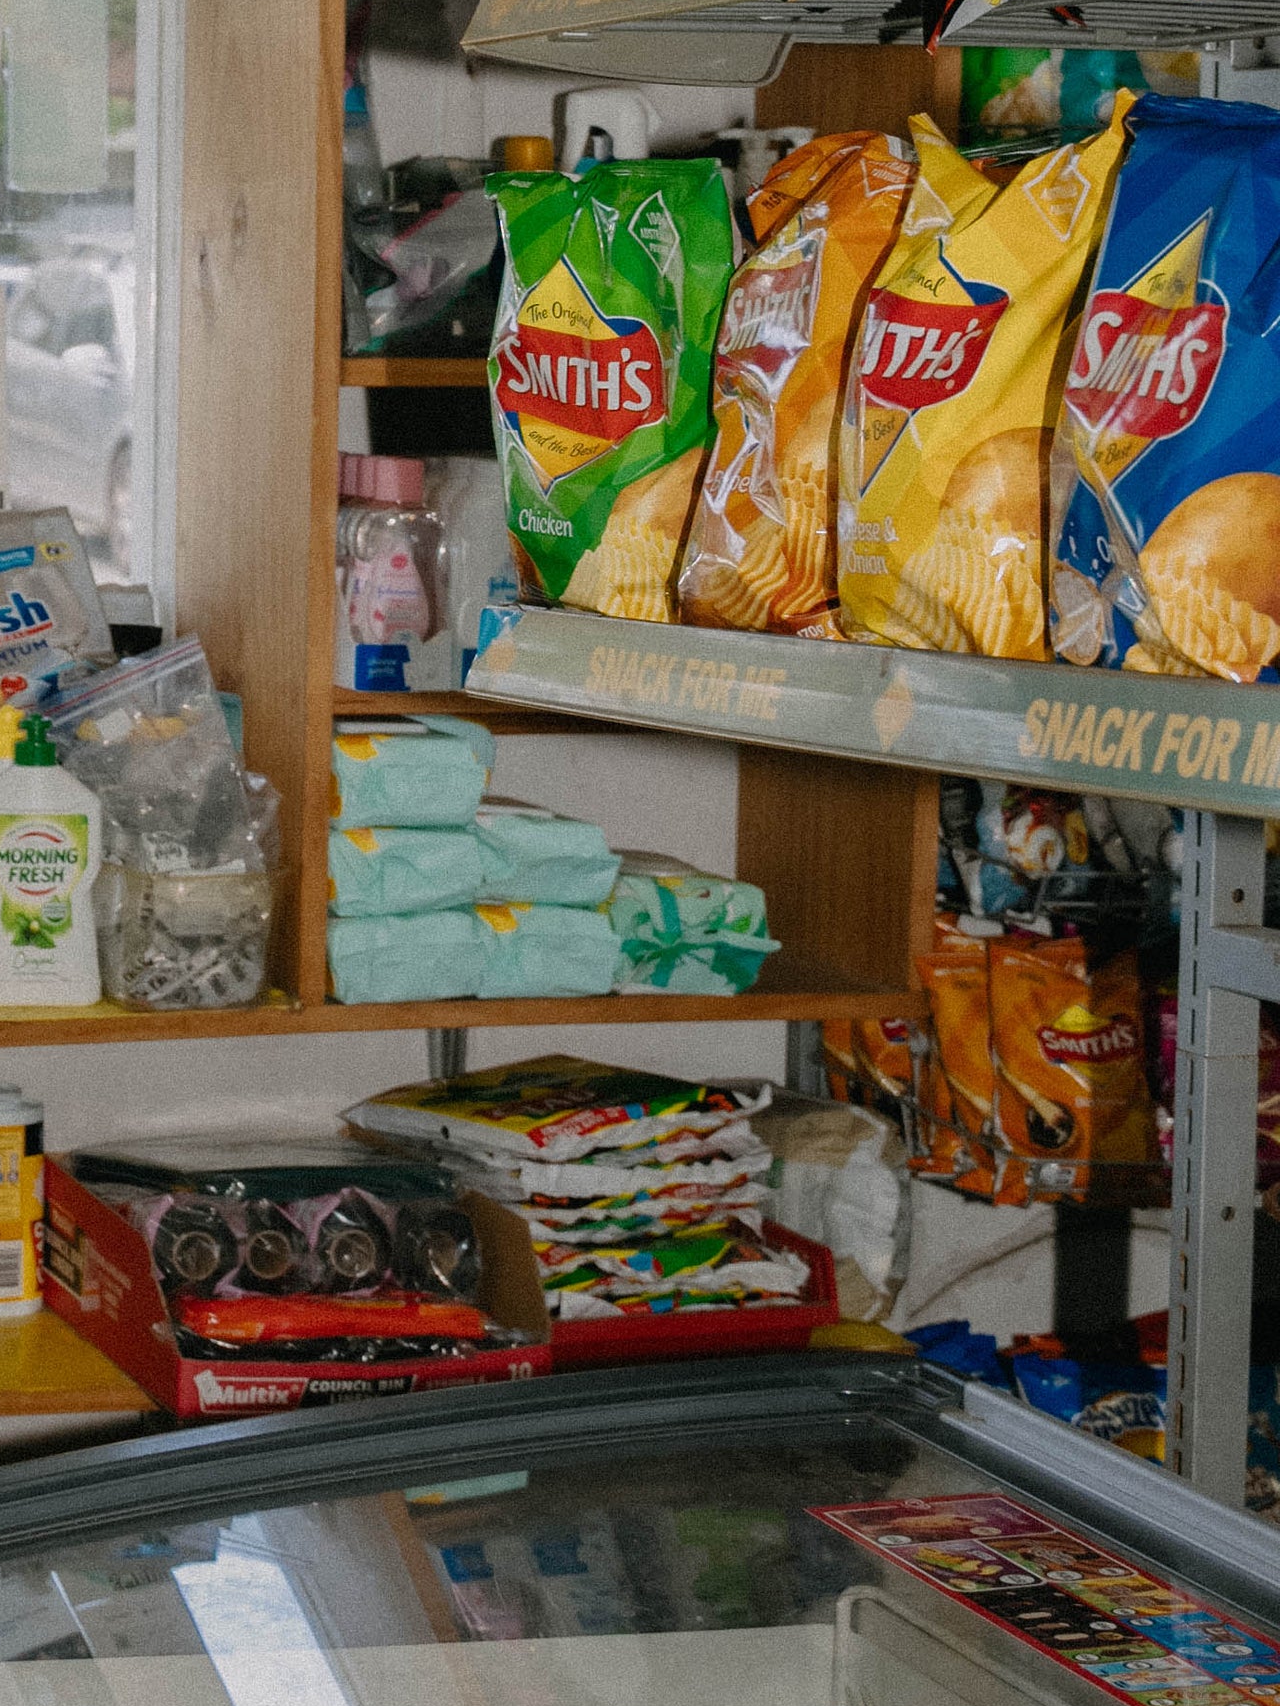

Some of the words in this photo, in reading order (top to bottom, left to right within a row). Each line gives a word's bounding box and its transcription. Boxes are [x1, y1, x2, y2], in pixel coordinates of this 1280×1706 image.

[526, 299, 550, 323] The
[551, 301, 594, 334] Original
[1068, 310, 1208, 404] SMITH'S
[504, 335, 653, 413] SMITH'S
[873, 414, 897, 436] Best
[528, 428, 549, 448] and
[548, 433, 570, 457] the
[570, 440, 600, 459] Best
[1104, 443, 1134, 465] Best
[518, 508, 574, 539] Chicken
[884, 517, 899, 543] &
[589, 646, 681, 704] SNACK
[678, 655, 737, 713] FOR
[731, 671, 788, 723] ME
[1022, 699, 1156, 772] SNACK
[1152, 714, 1242, 781] FOR
[7, 865, 65, 884] FRESH
[1042, 1020, 1137, 1055] SMITH'S
[213, 1381, 292, 1406] Multix
[309, 1377, 374, 1394] COUNCIL
[381, 1375, 407, 1391] BIN
